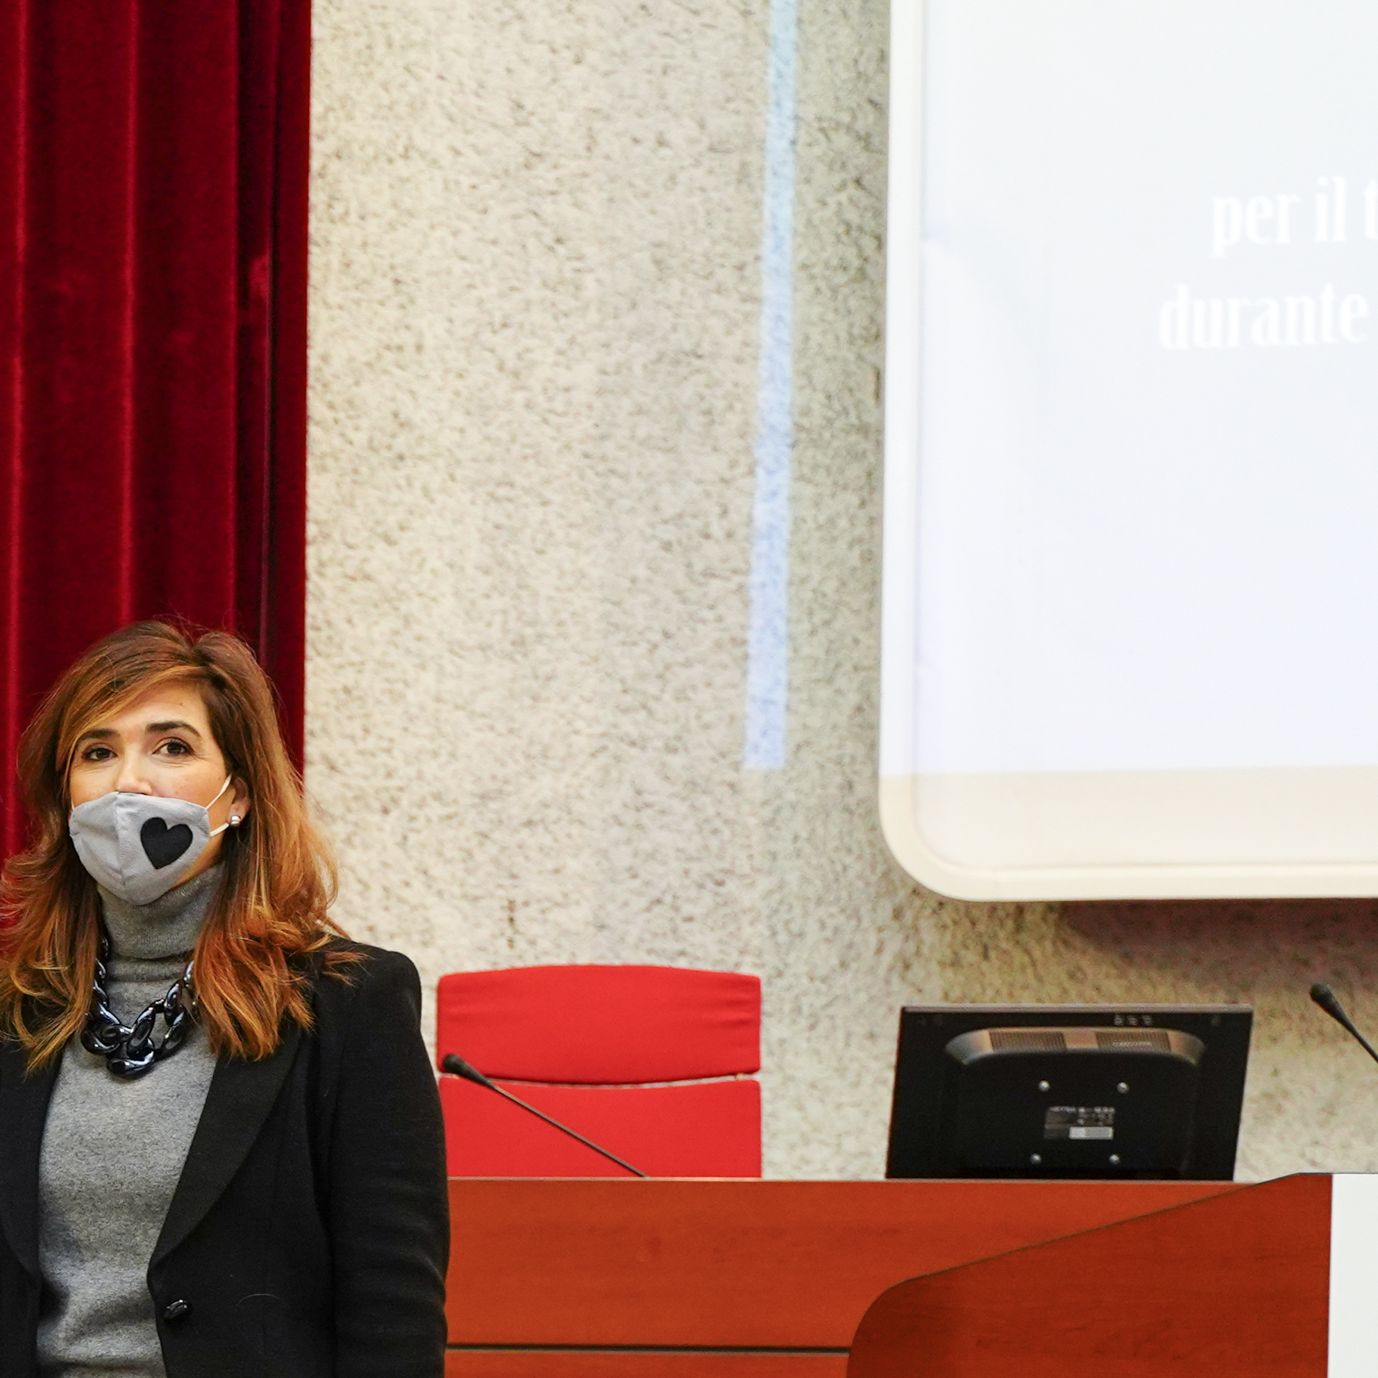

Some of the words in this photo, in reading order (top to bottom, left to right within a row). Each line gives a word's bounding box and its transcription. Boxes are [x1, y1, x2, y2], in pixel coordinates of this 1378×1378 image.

[1211, 194, 1301, 258] per
[1314, 175, 1347, 243] il
[1158, 282, 1369, 350] durante
